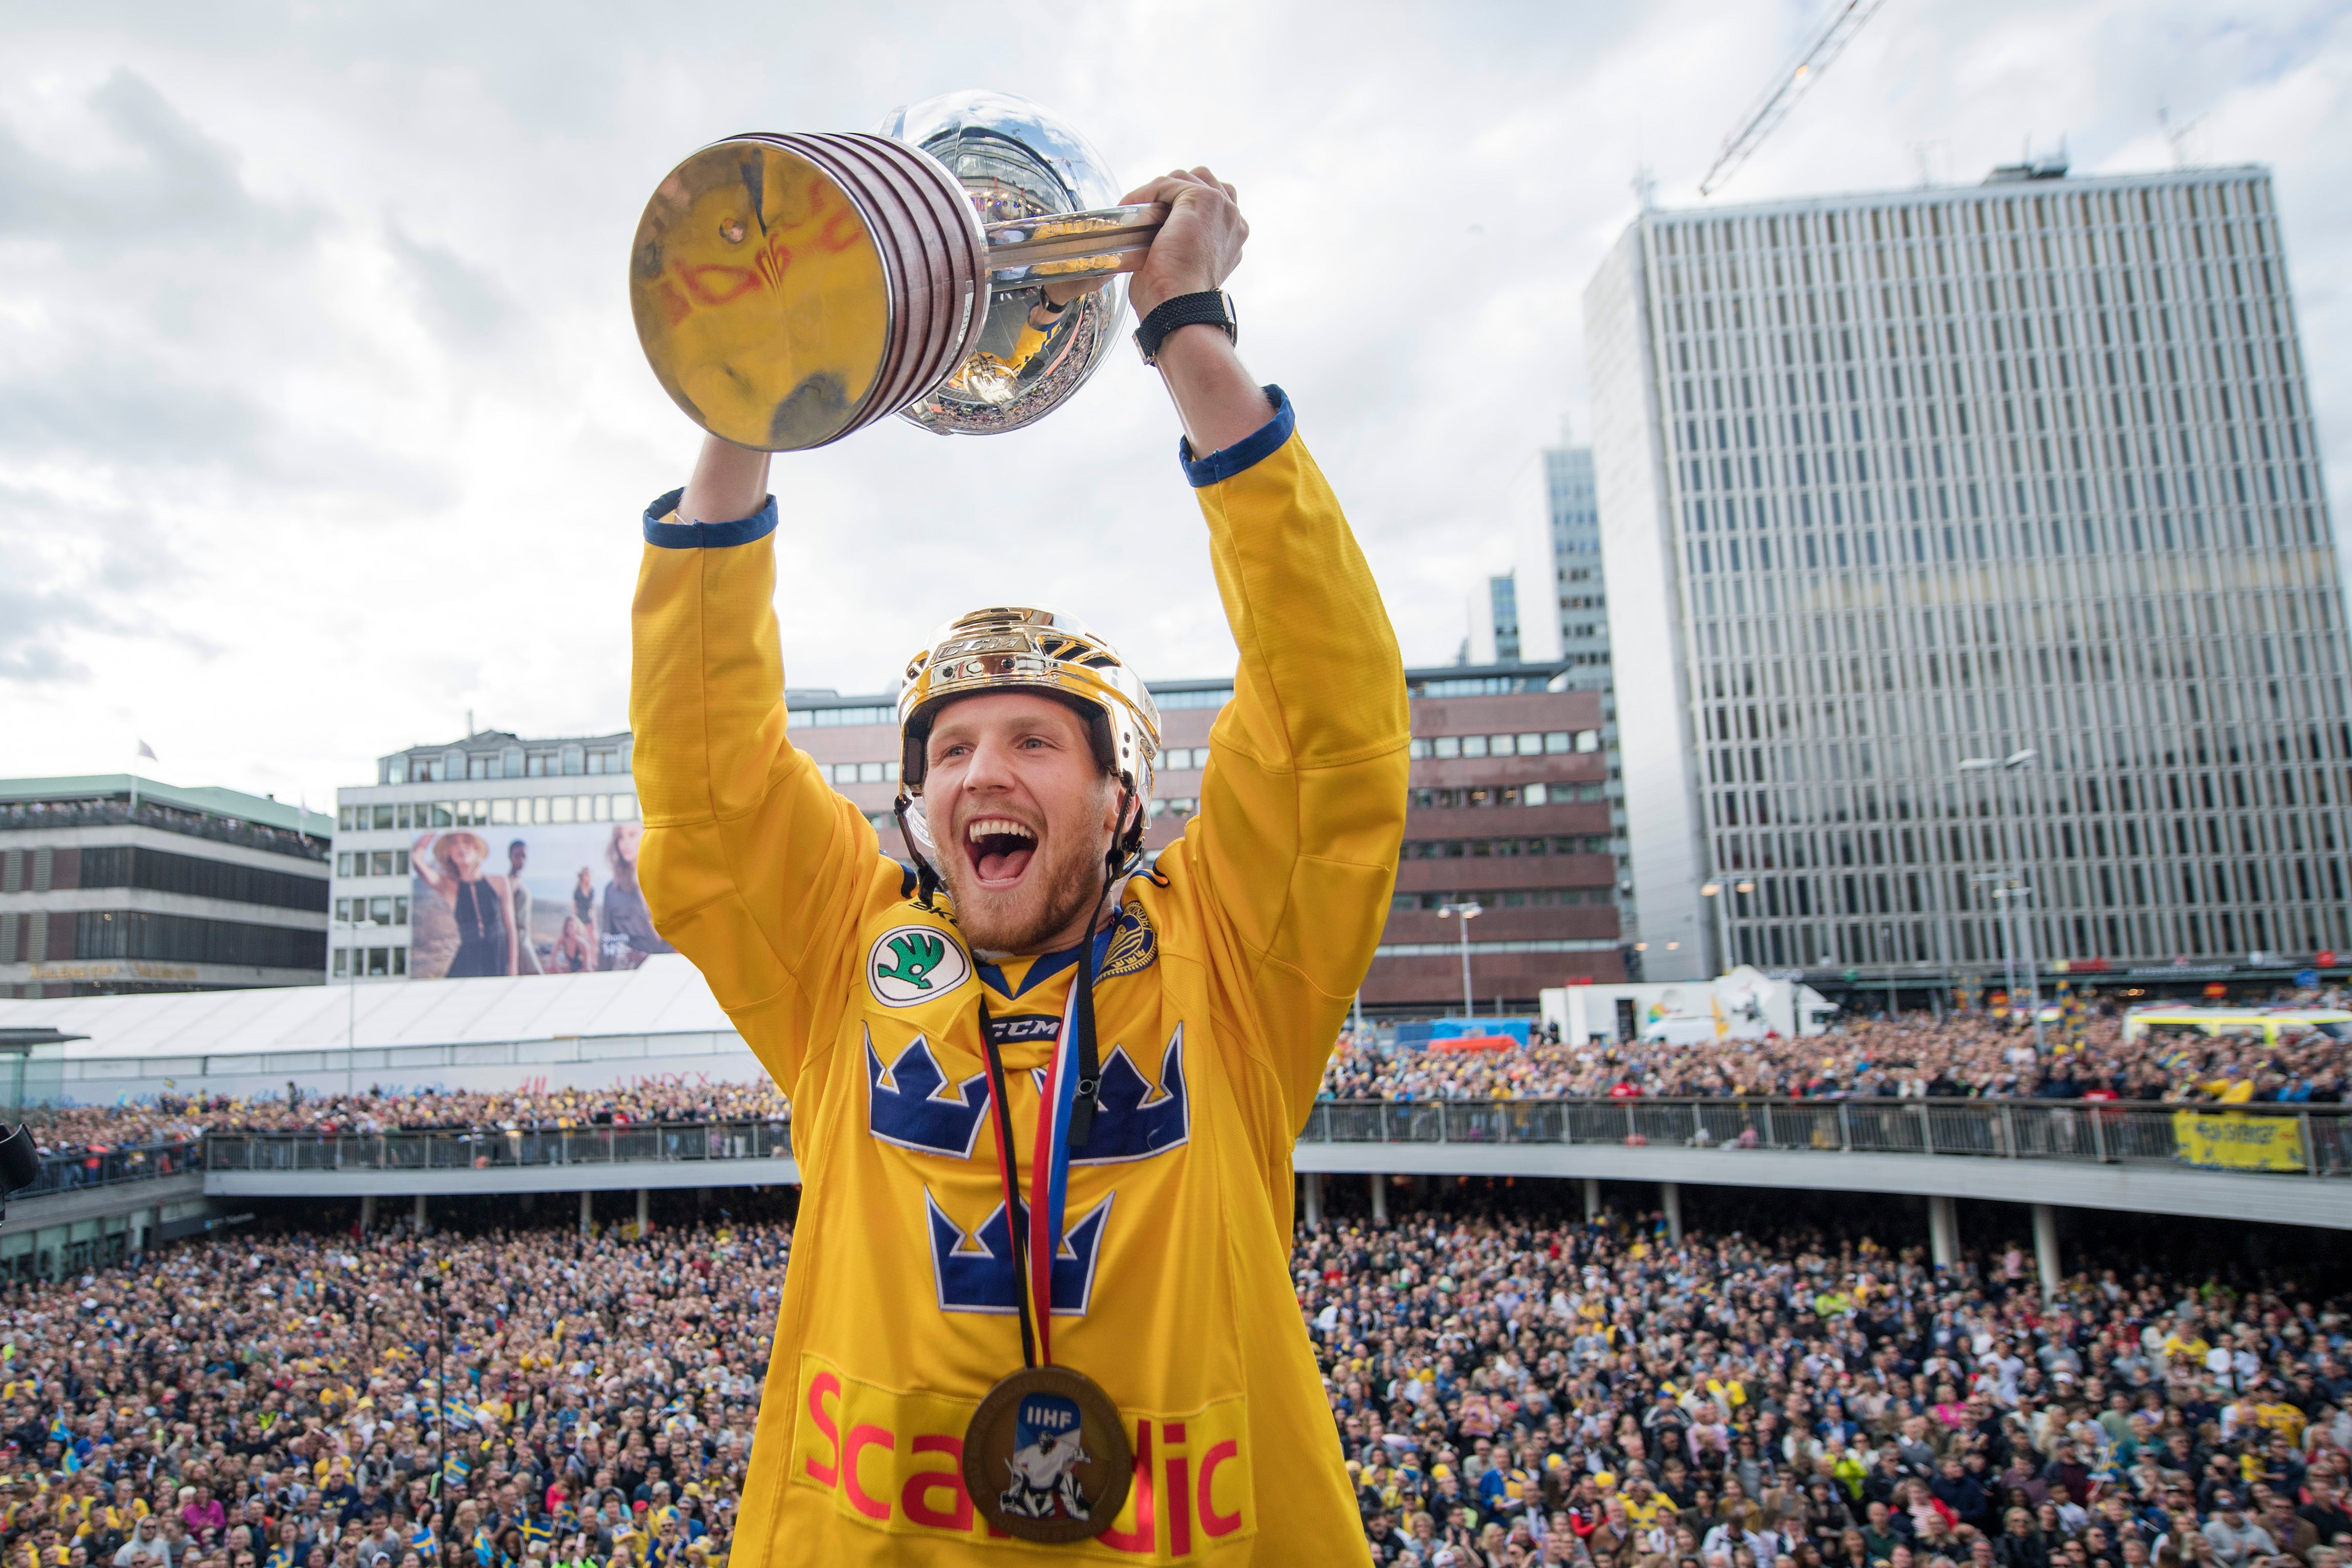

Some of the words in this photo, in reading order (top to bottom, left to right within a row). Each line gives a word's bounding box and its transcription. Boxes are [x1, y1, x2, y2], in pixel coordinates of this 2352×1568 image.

[938, 636, 1022, 658] CCM
[1027, 1406, 1072, 1429] IIHF
[806, 1372, 1242, 1558] Scadic
